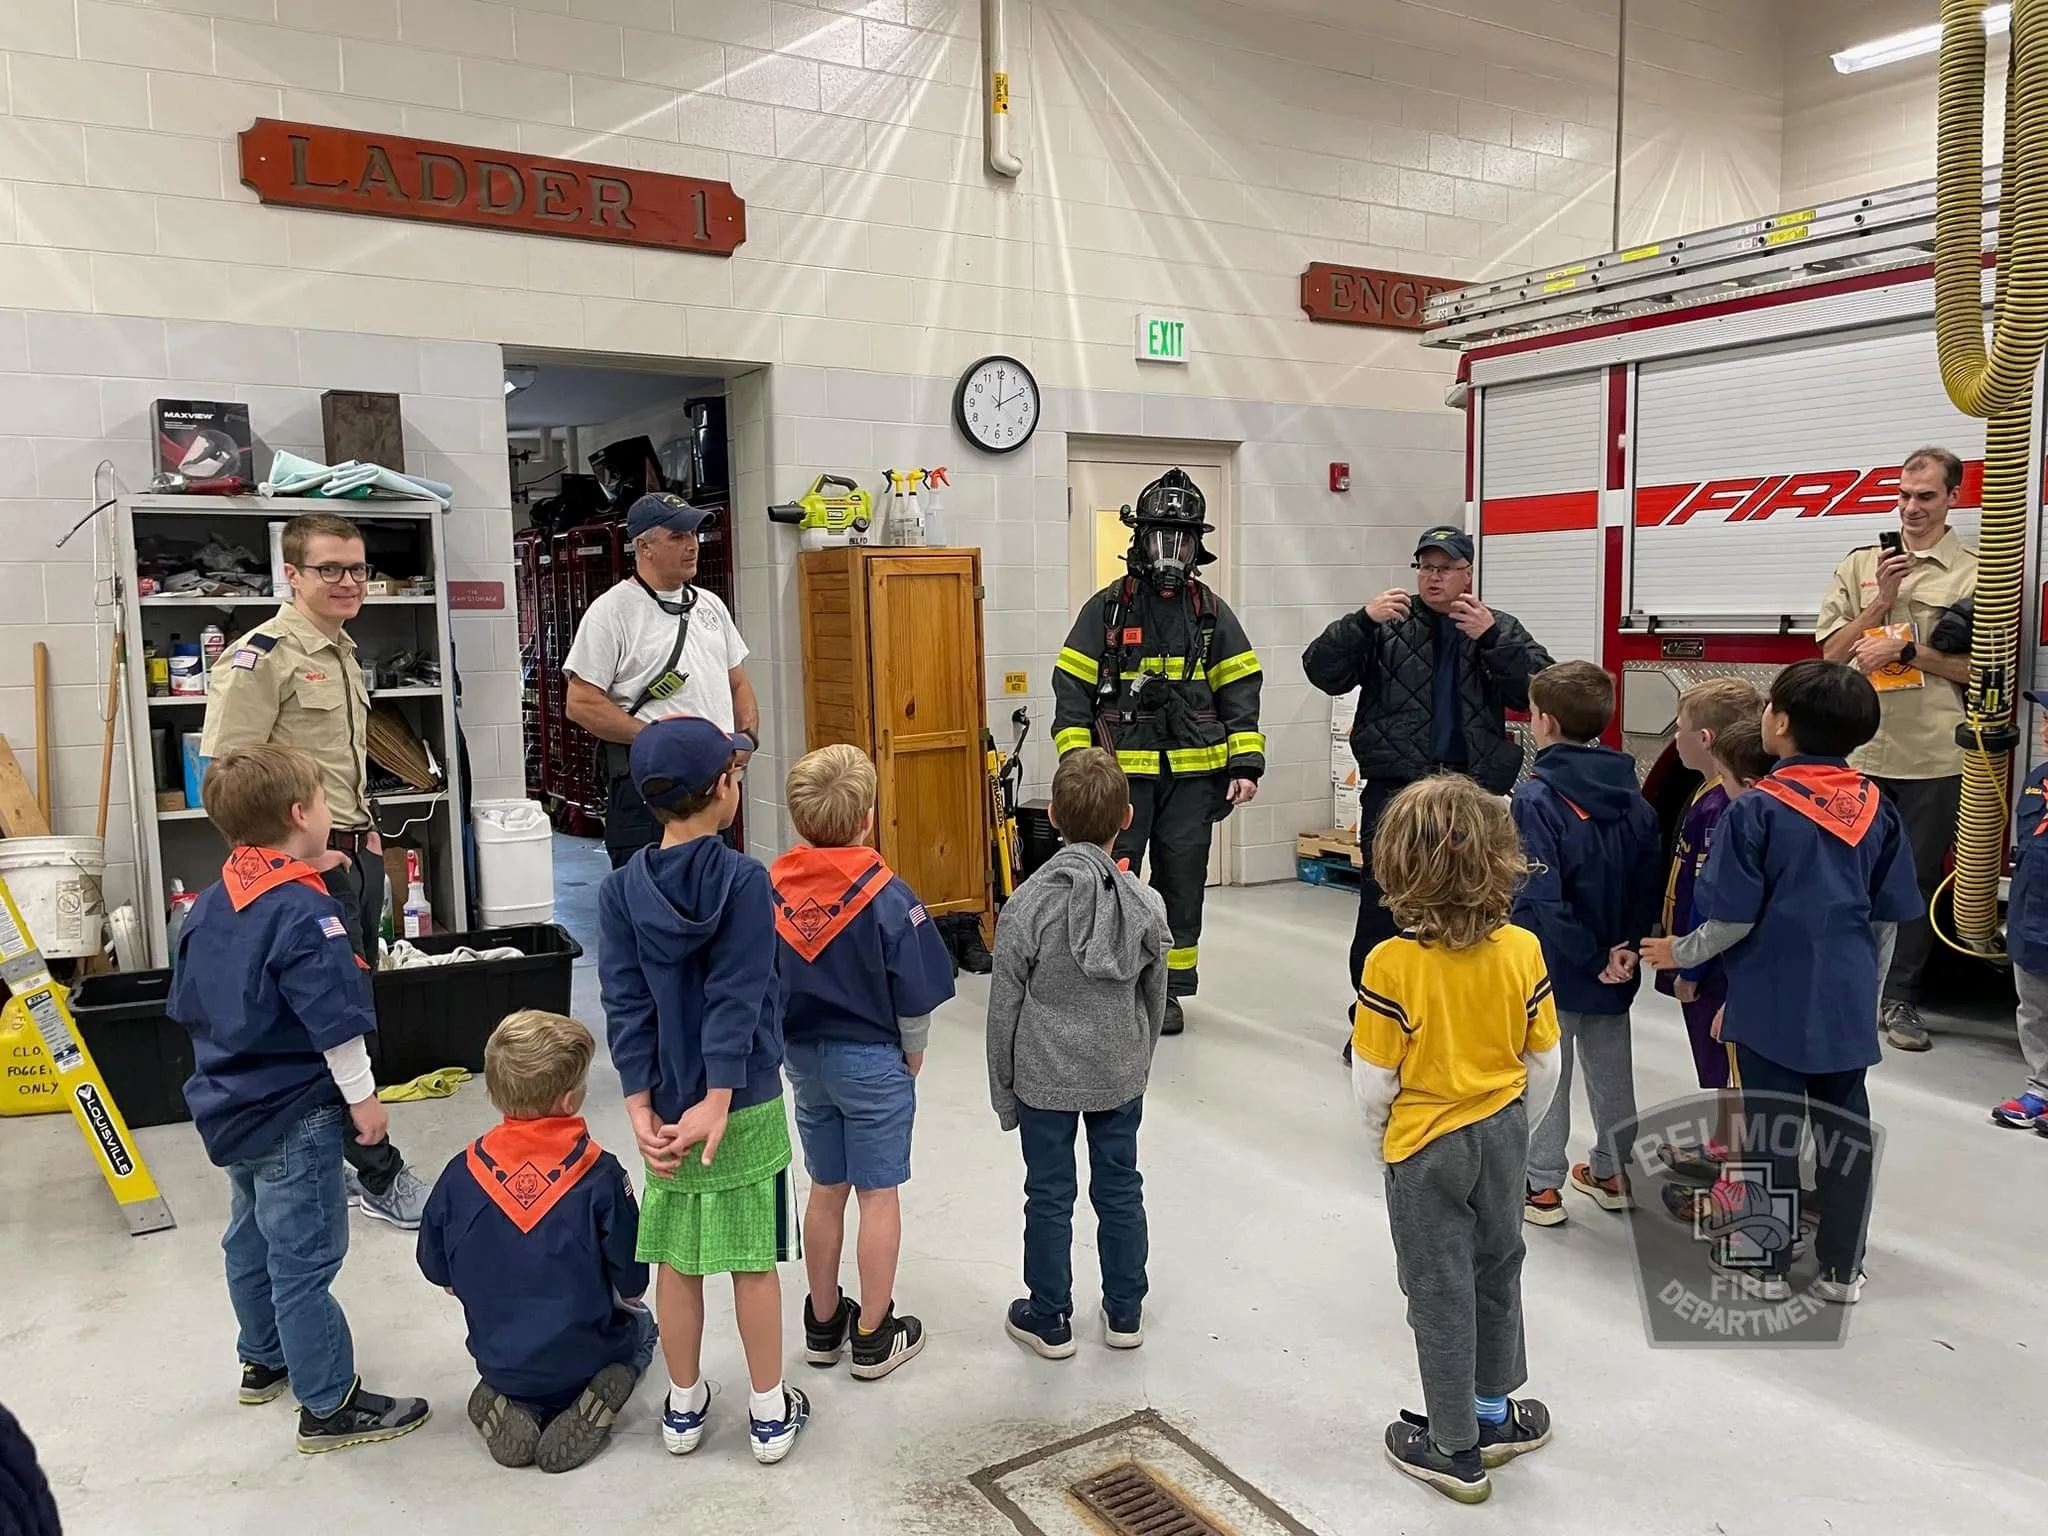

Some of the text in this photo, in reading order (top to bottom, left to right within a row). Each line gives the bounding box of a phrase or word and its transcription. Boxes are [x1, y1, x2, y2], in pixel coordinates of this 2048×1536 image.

[287, 135, 712, 240] LADDER 1
[1149, 320, 1184, 357] EXIT
[984, 373, 991, 382] 11
[997, 370, 1006, 380] 12
[1012, 376, 1016, 384] 1
[974, 383, 983, 393] 10
[1019, 387, 1025, 397] 2
[969, 398, 976, 407] 9
[1022, 403, 1029, 412] 3
[164, 411, 214, 420] MAXVIEW
[973, 413, 979, 422] 8
[1017, 417, 1023, 425] 4
[983, 425, 989, 434] 7
[1007, 427, 1013, 436] 5
[994, 430, 1001, 439] 6
[1666, 466, 1900, 525] FIRE
[8, 1064, 52, 1077] FOGGE
[19, 1082, 59, 1095] ONLY
[86, 1098, 130, 1175] LOUISVILLE
